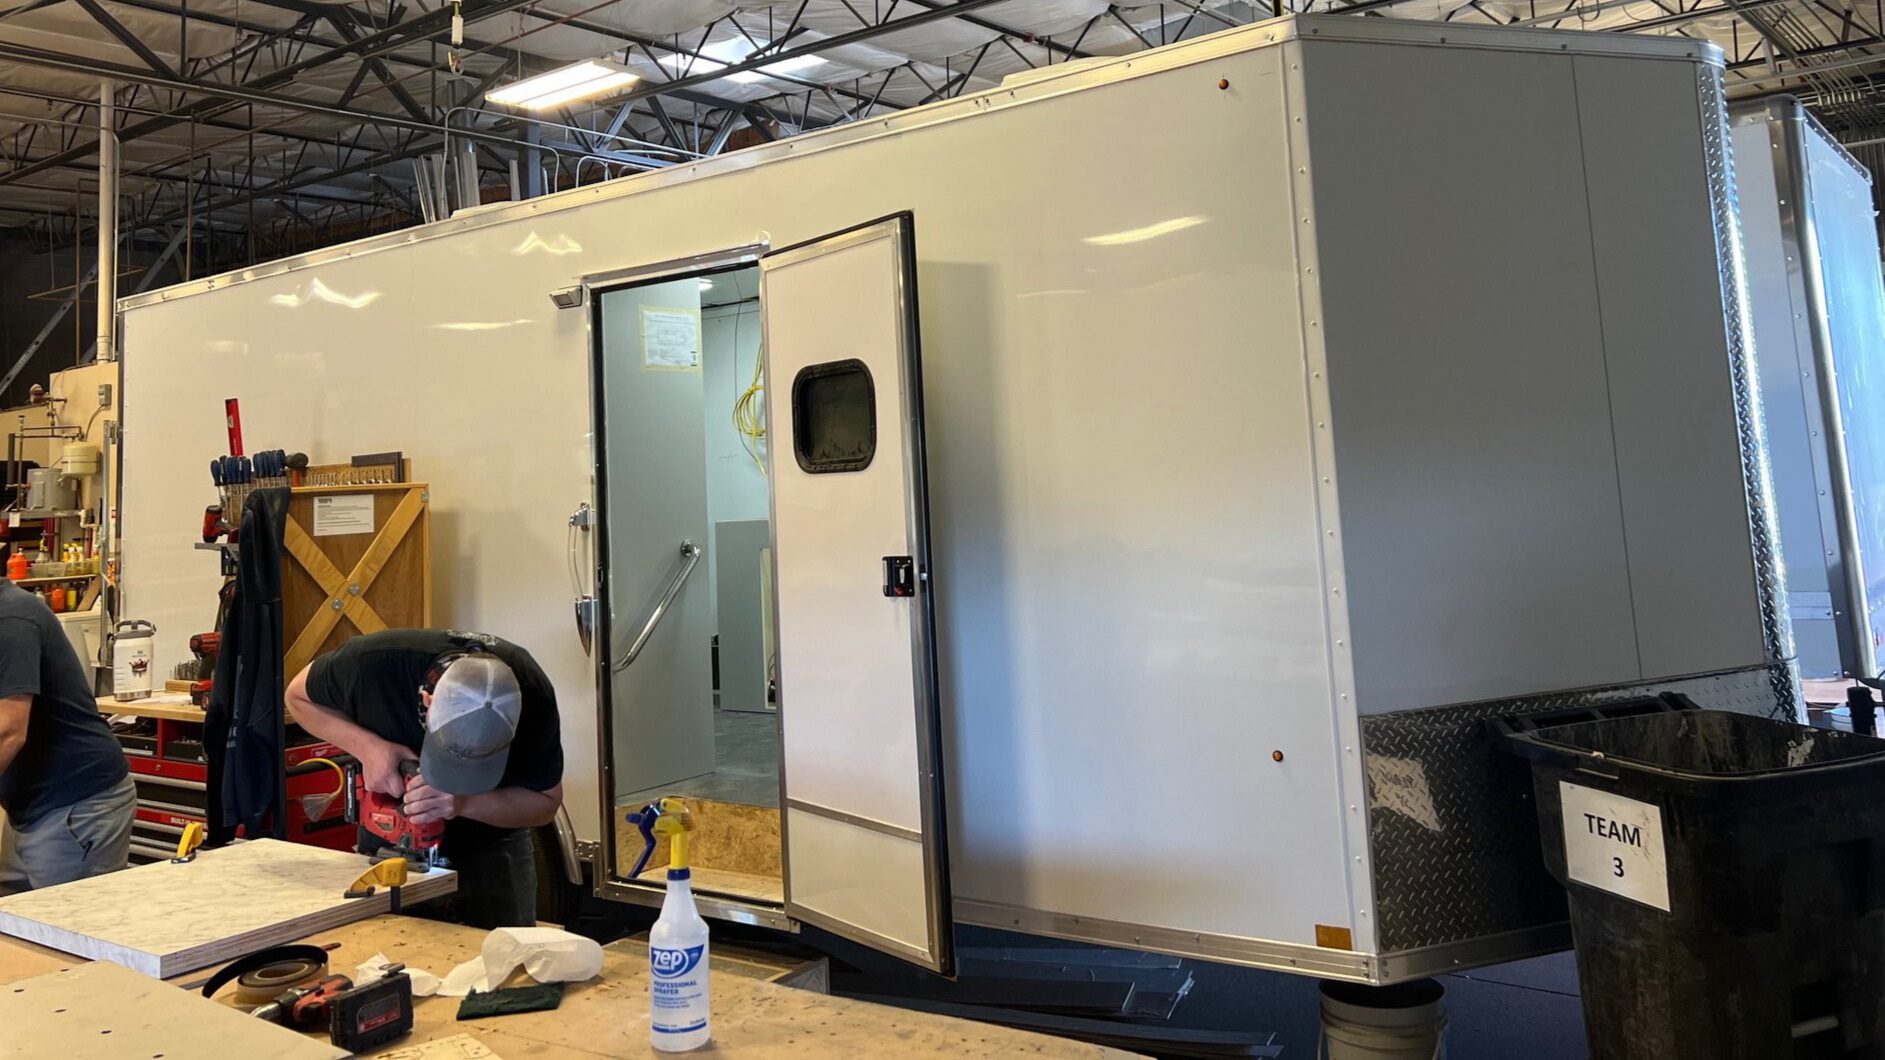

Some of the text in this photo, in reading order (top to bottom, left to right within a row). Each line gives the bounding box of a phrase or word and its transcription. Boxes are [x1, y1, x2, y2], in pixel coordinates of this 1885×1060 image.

[1583, 812, 1642, 848] TEAM
[1612, 857, 1625, 878] 3
[653, 979, 697, 988] PROFESSIONAL
[653, 986, 679, 995] SPRAYER
